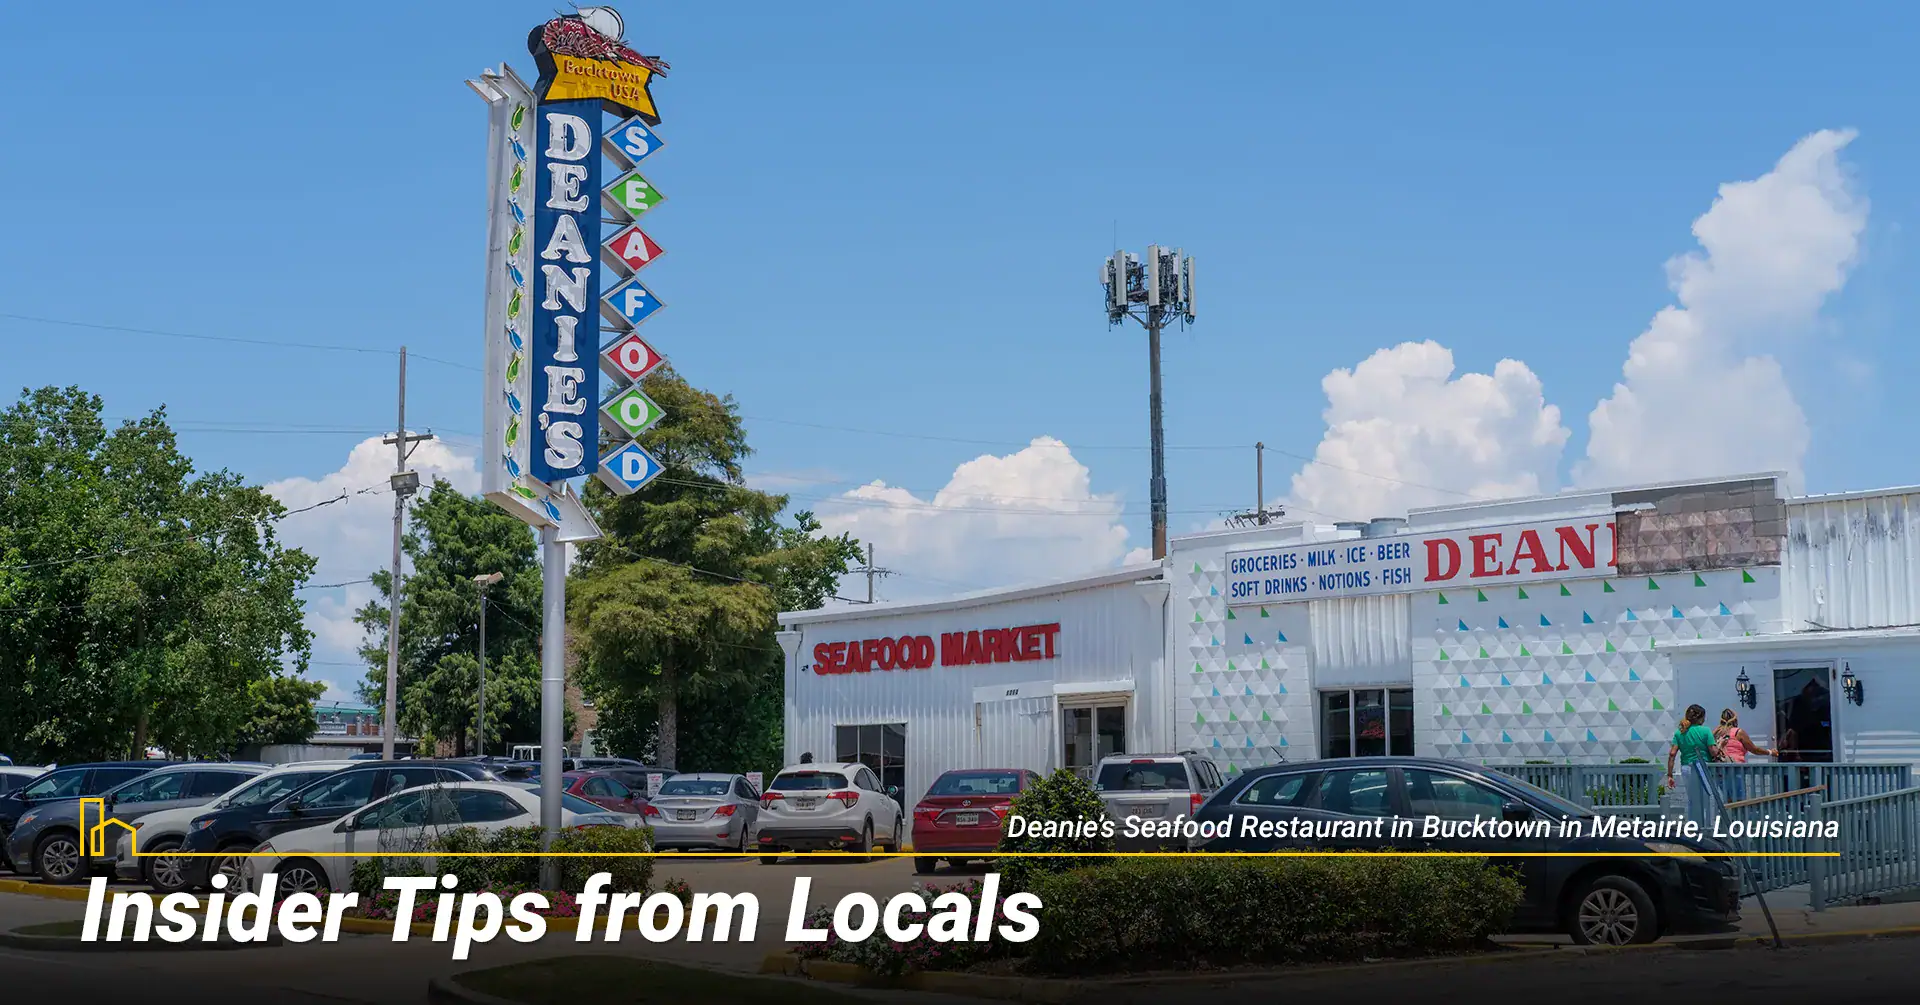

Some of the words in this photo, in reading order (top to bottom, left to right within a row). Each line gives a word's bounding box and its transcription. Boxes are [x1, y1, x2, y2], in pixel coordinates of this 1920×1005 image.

[563, 59, 640, 85] Bucktown
[610, 81, 640, 102] USA
[538, 113, 593, 470] DEANIE'S
[620, 127, 650, 481] SEAFOOD
[1231, 553, 1297, 574] GROCERIES
[1307, 550, 1336, 567] MILK
[1346, 546, 1366, 563] ICE
[1377, 542, 1410, 560] BEER
[1231, 580, 1260, 597] SOFT
[1265, 576, 1308, 594] DRINKS
[1319, 571, 1371, 590] NOTIONS
[1382, 567, 1411, 585] FISH
[813, 635, 935, 675] SEAFOOD
[941, 623, 1060, 667] MARKET
